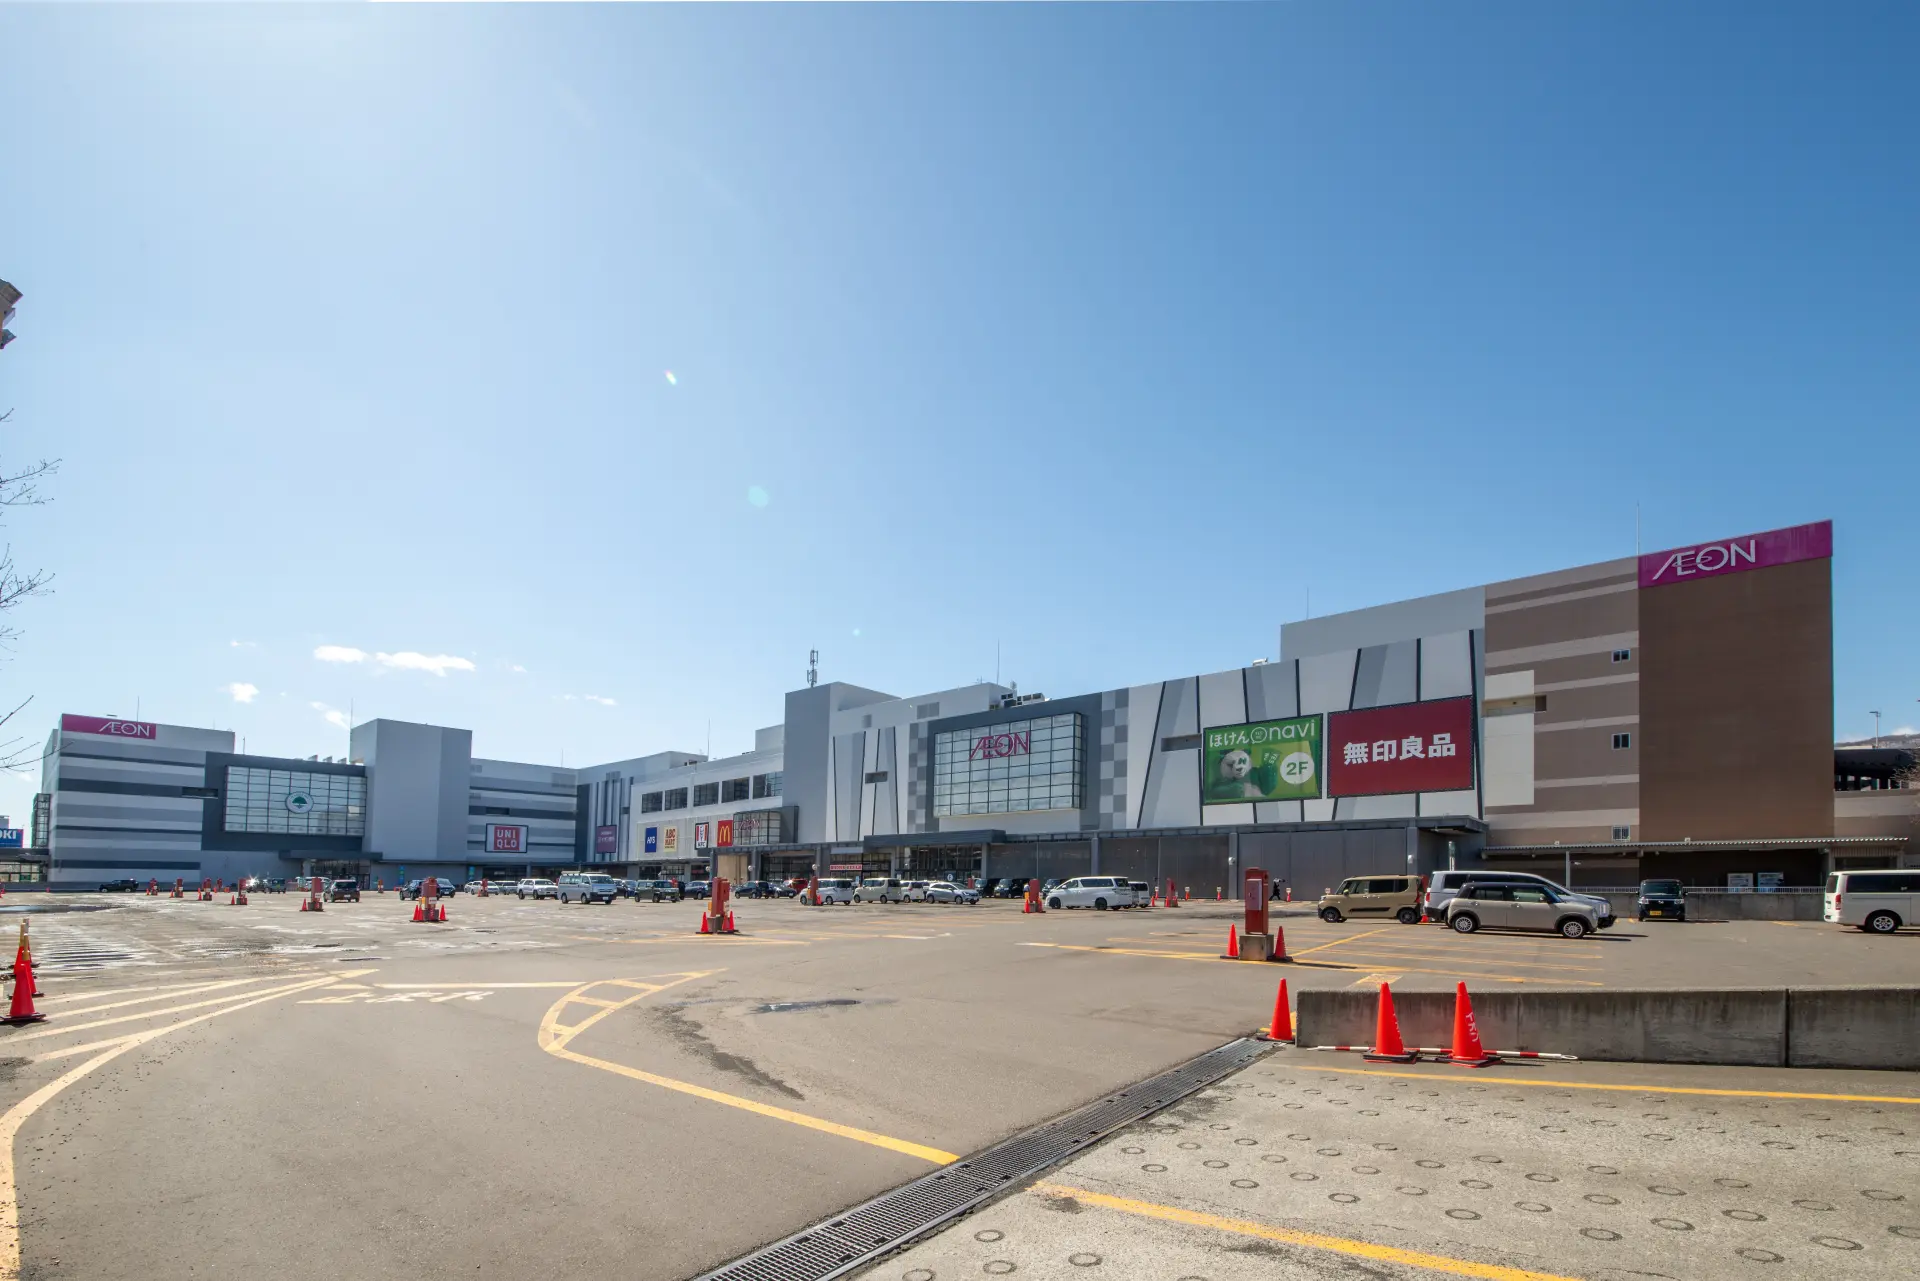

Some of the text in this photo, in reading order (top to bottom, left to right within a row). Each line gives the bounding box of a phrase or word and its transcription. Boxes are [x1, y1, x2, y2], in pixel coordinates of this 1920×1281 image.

[1209, 719, 1316, 748] ほけん navi
[1343, 732, 1456, 766] 無印良品
[1286, 761, 1309, 776] 2F
[496, 829, 517, 838] UNI
[665, 829, 676, 838] ABC
[496, 839, 517, 849] QLO
